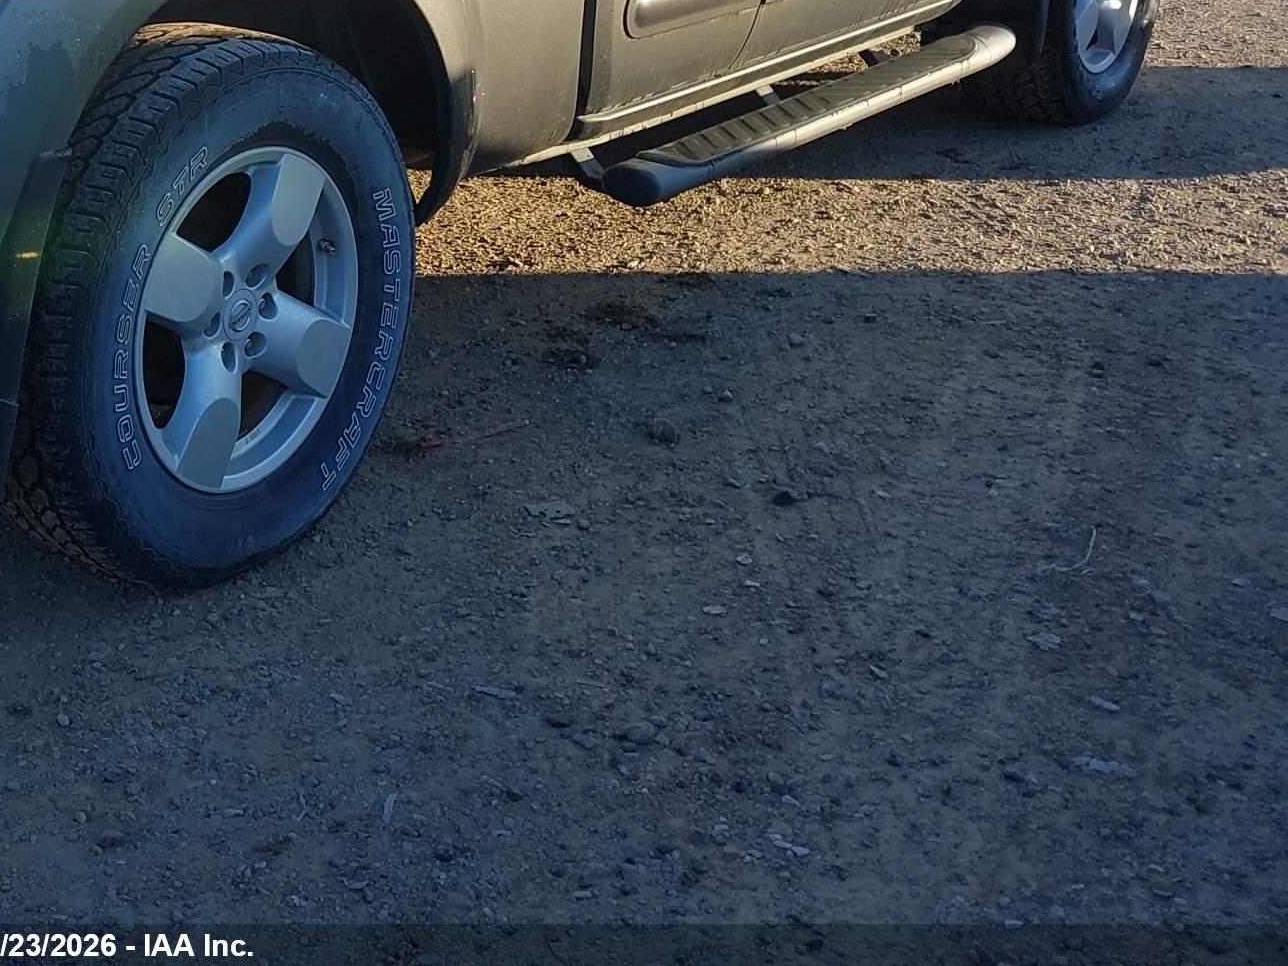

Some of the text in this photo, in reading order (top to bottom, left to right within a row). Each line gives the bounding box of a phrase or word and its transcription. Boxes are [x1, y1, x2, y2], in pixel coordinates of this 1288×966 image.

[113, 145, 209, 470] COURSER STR
[322, 187, 402, 491] MASTERCRAFT
